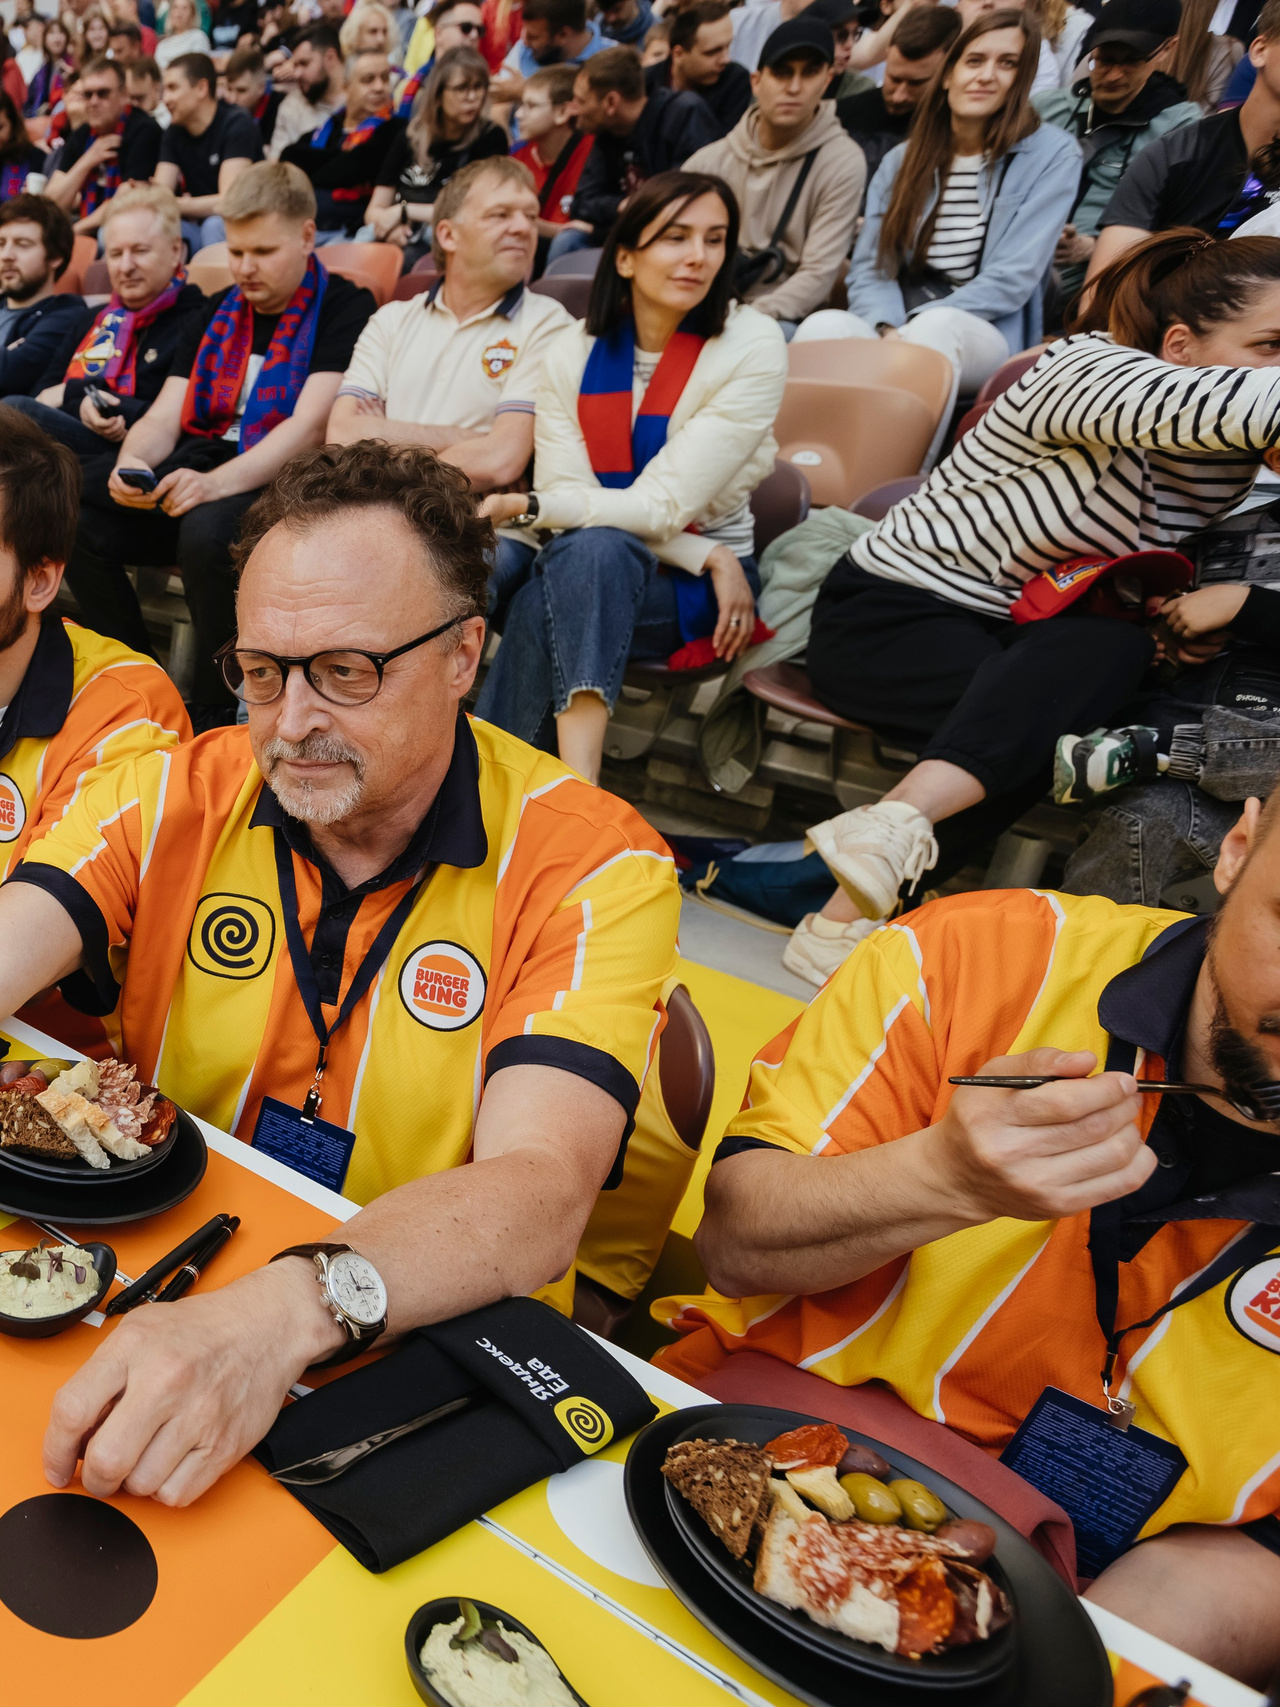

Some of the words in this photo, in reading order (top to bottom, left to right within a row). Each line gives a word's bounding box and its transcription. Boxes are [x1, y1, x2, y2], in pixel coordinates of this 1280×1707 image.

[413, 981, 467, 1008] KING
[416, 968, 469, 992] BURGER
[475, 1337, 555, 1401] Яндекс
[527, 1357, 570, 1394] Еда
